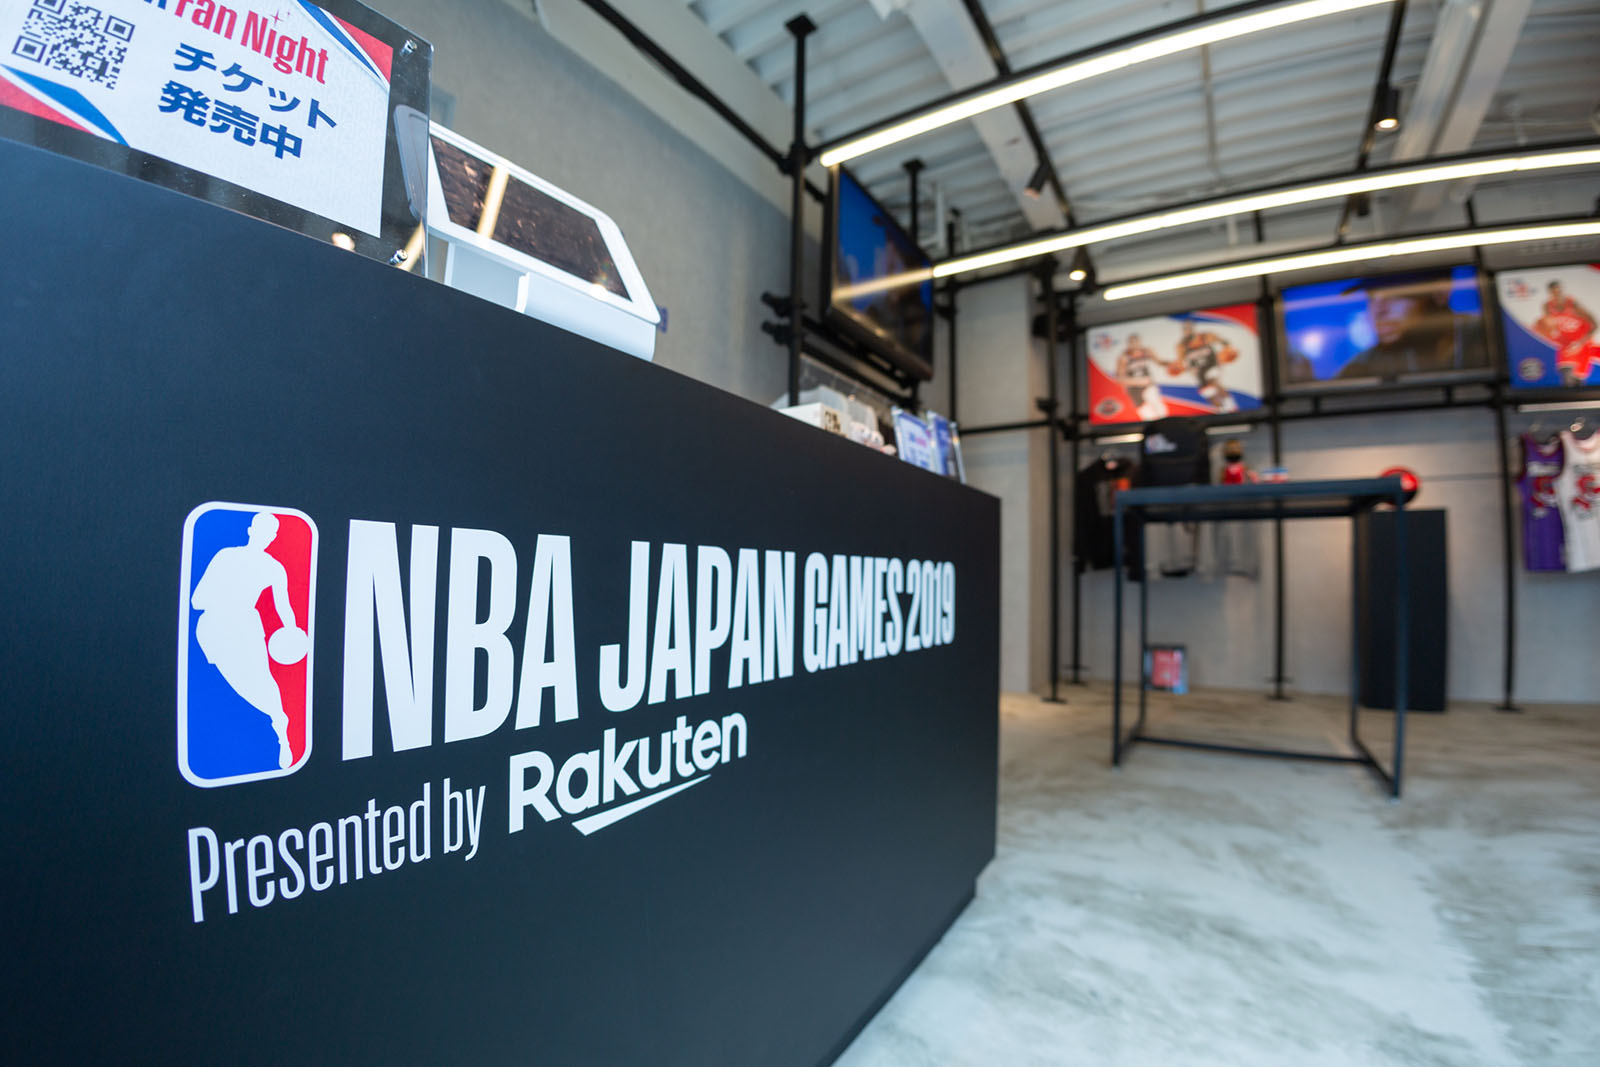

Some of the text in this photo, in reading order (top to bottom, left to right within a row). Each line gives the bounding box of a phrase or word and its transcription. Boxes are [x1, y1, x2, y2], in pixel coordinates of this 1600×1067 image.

[173, 42, 337, 129] チケット
[240, 10, 329, 85] Night
[158, 80, 303, 160] 発売中
[341, 518, 956, 761] NBA JAPAN GAMES 2019
[188, 712, 748, 923] Presented by Rakuten
